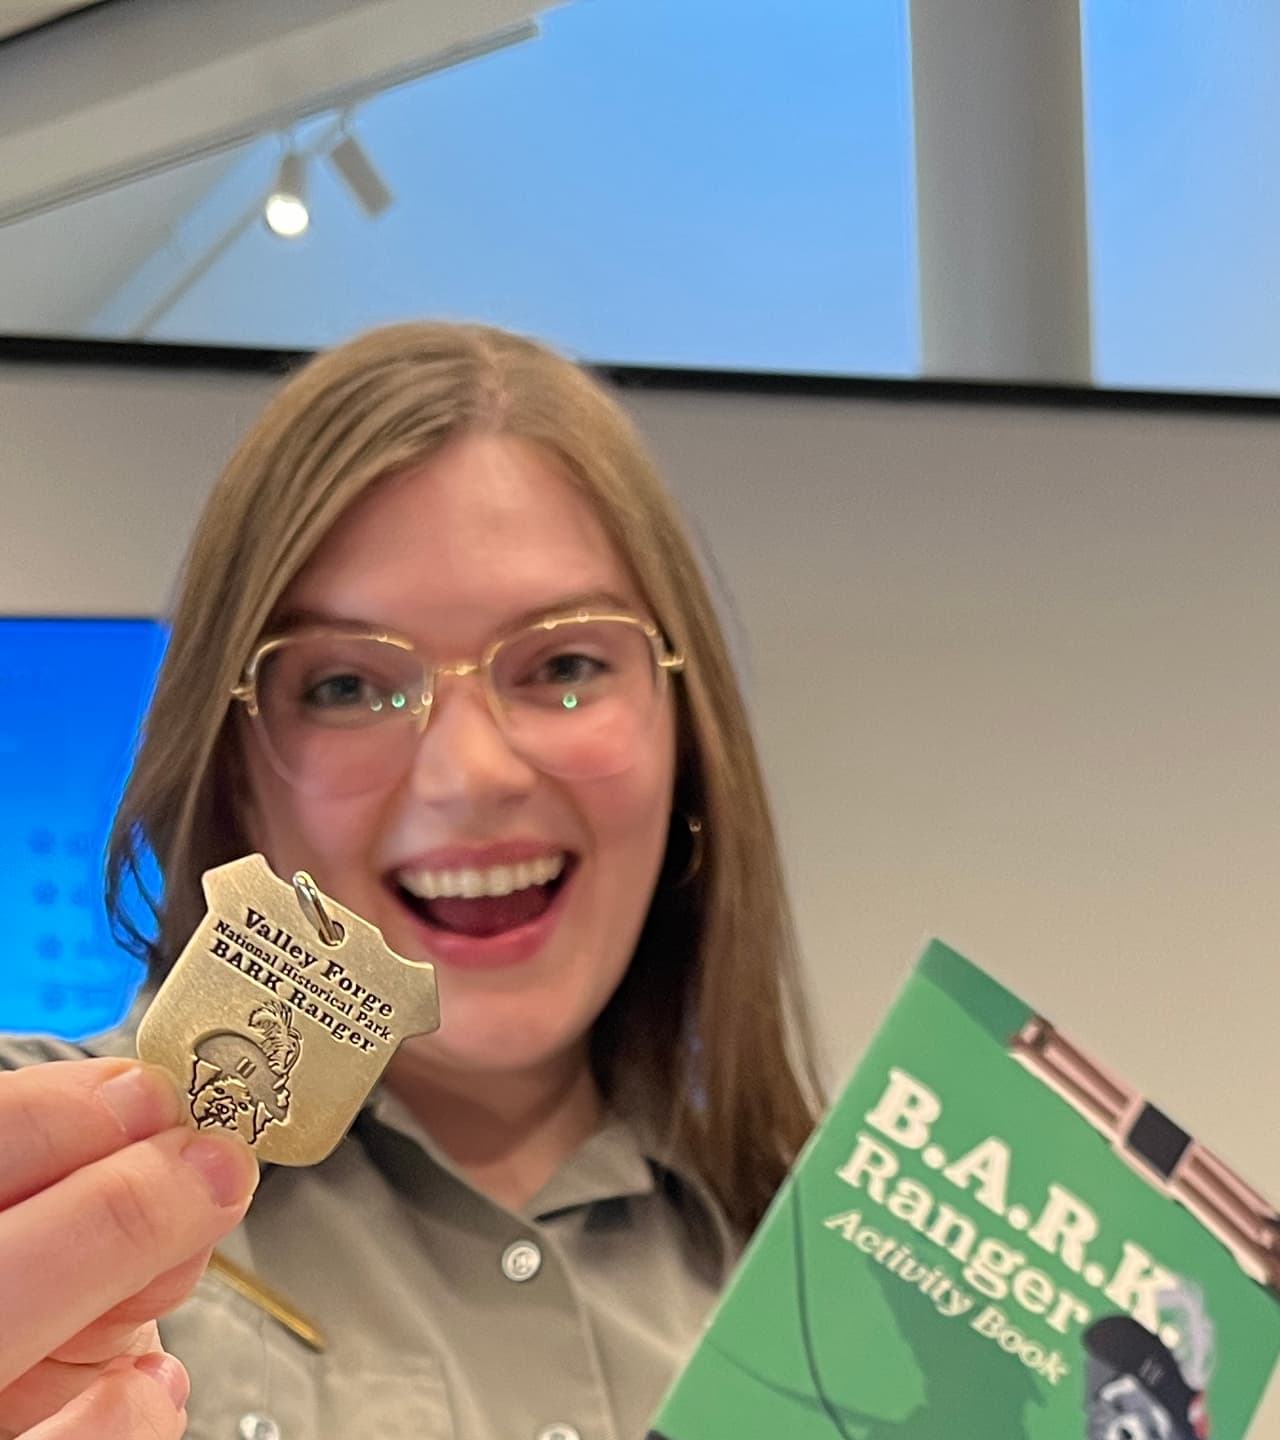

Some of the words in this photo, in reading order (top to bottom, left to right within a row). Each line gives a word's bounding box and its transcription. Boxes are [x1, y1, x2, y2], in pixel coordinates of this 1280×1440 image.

[209, 938, 284, 994] BARK
[288, 988, 374, 1052] Ranger
[213, 919, 279, 968] National
[281, 962, 354, 1016] Historical
[356, 1011, 392, 1041] Park
[245, 907, 319, 969] Valley
[321, 960, 393, 1017] Forge
[835, 1131, 1091, 1335] Ranger
[864, 1066, 1181, 1350] B.A.R.K.
[823, 1209, 974, 1318] Activity
[971, 1303, 1070, 1386] Book
